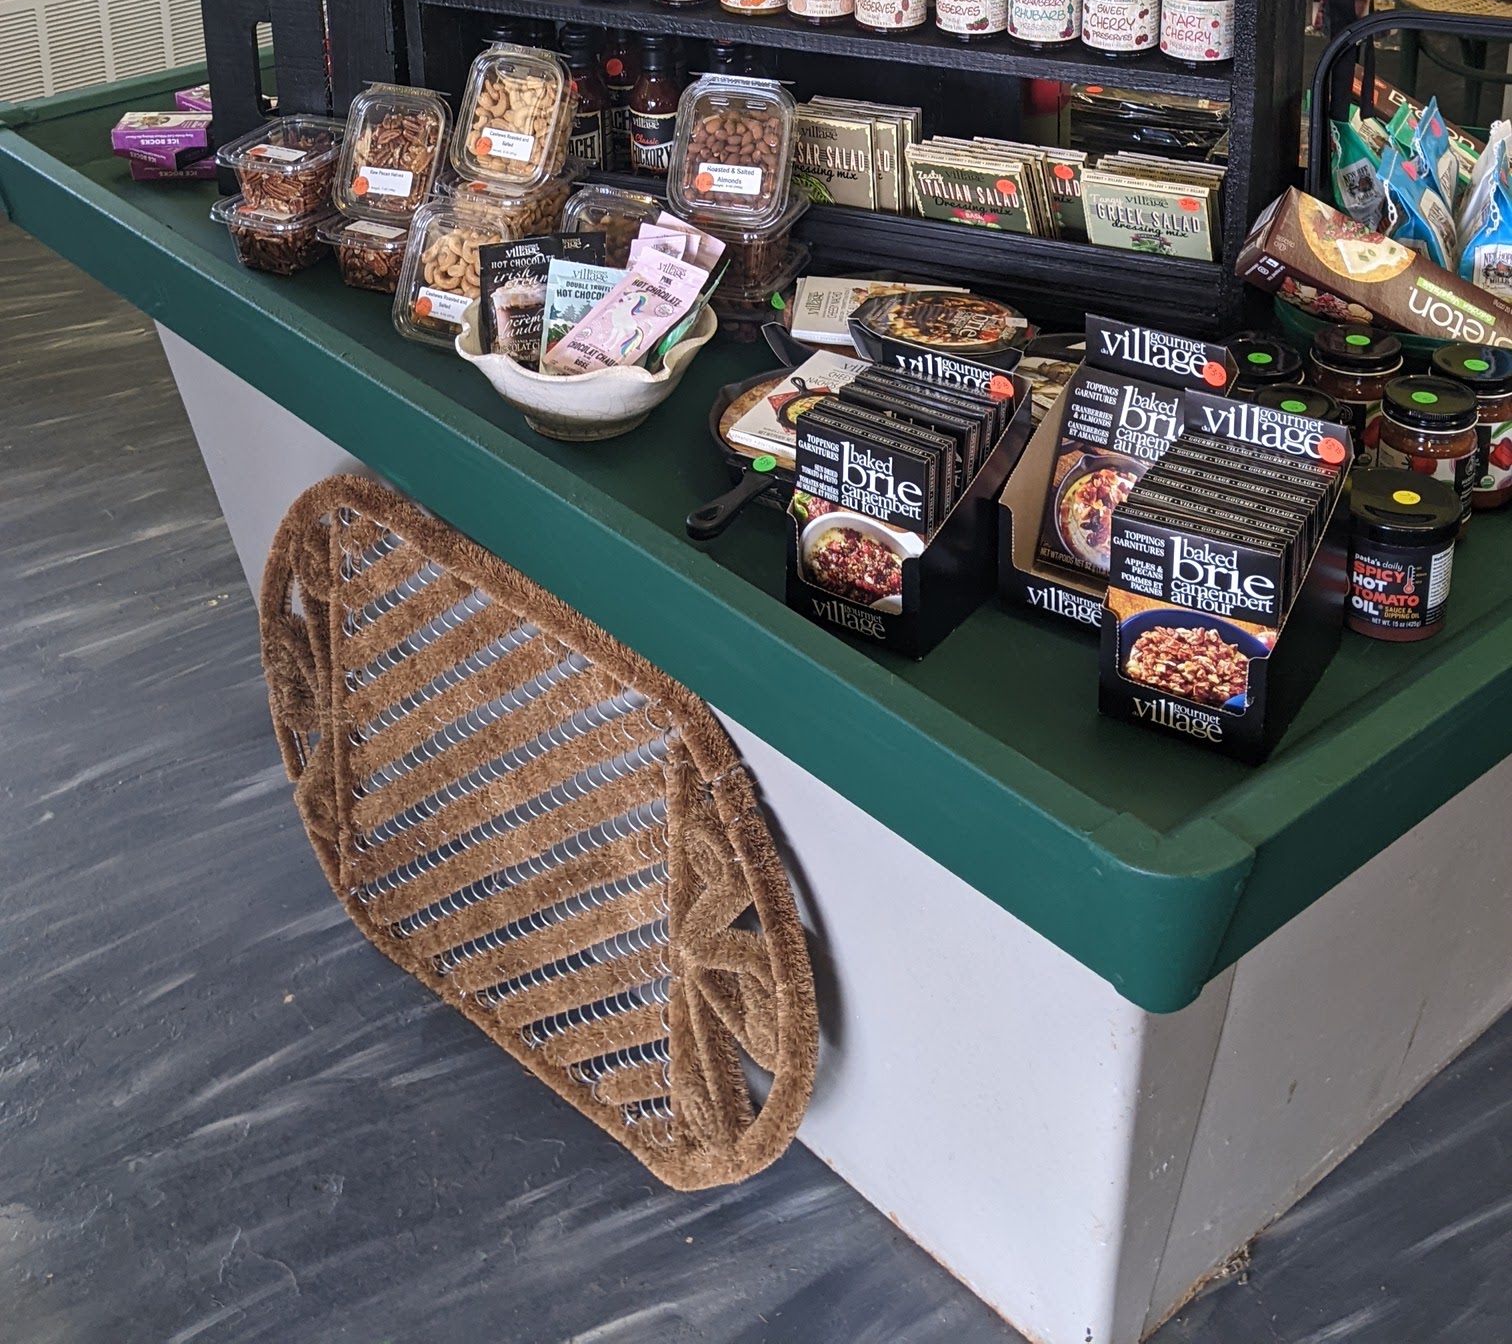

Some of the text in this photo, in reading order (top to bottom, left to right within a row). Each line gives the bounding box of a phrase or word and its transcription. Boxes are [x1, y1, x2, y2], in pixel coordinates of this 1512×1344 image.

[1015, 7, 1065, 19] RHUBARB
[1097, 5, 1128, 17] SWEET
[1170, 13, 1205, 28] TART
[1090, 16, 1135, 32] CHERRY
[1092, 30, 1132, 41] PRESERVES
[1166, 28, 1211, 43] CHERRY
[1388, 89, 1476, 151] Breon
[707, 165, 730, 174] Roasted
[826, 146, 865, 172] SALAD
[717, 176, 742, 185] Almonds
[837, 170, 858, 180] mix
[916, 170, 944, 183] Zesty
[920, 179, 1020, 209] ITALIAN SALAD
[1089, 193, 1123, 207] Tangy
[1097, 205, 1200, 233] GREEK SALAD
[1111, 219, 1188, 238] dressing mix
[513, 255, 555, 268] CHOCOLAT
[566, 281, 589, 290] DOUBLE
[572, 268, 609, 283] village
[557, 289, 573, 298] HOT
[632, 278, 682, 306] HOT CHOCOLATE
[1101, 327, 1209, 378] village
[1150, 332, 1206, 355] gourmet
[942, 358, 994, 381] gourmet
[1075, 388, 1117, 406] GARNITURES
[1086, 381, 1119, 396] TOPPINGS
[1072, 403, 1113, 420] CRANBERRIES
[1133, 387, 1178, 417] baked
[1068, 420, 1110, 438] CANNEBERGES
[1079, 414, 1112, 428] ALMONDS
[1260, 408, 1324, 433] gourmet
[1203, 404, 1325, 460] village
[798, 440, 839, 462] GARNITURES
[807, 434, 839, 452] TOPPINGS
[851, 444, 893, 476] baked
[840, 441, 923, 506] brie
[841, 483, 922, 520] camembert
[841, 495, 891, 521] au four
[1113, 536, 1165, 557] GARNITURES
[1124, 530, 1165, 548] TOPPINGS
[1125, 557, 1156, 571] APPLES
[1184, 538, 1238, 570] baked
[1355, 553, 1403, 572] pasta's daily
[1132, 567, 1163, 581] PECANS
[1170, 536, 1276, 601] brie
[1354, 560, 1405, 583] SPICY
[1353, 571, 1388, 592] HOT
[1171, 579, 1273, 614] camembert
[1171, 590, 1234, 617] au four
[1352, 595, 1380, 616] OIL
[1353, 584, 1420, 606] TOMATO
[1027, 586, 1102, 628] village
[1385, 606, 1405, 614] SAUCE
[1385, 611, 1409, 619] DIPPING
[811, 599, 886, 640] village
[1132, 696, 1224, 743] village
[1173, 704, 1221, 725] gourmet
